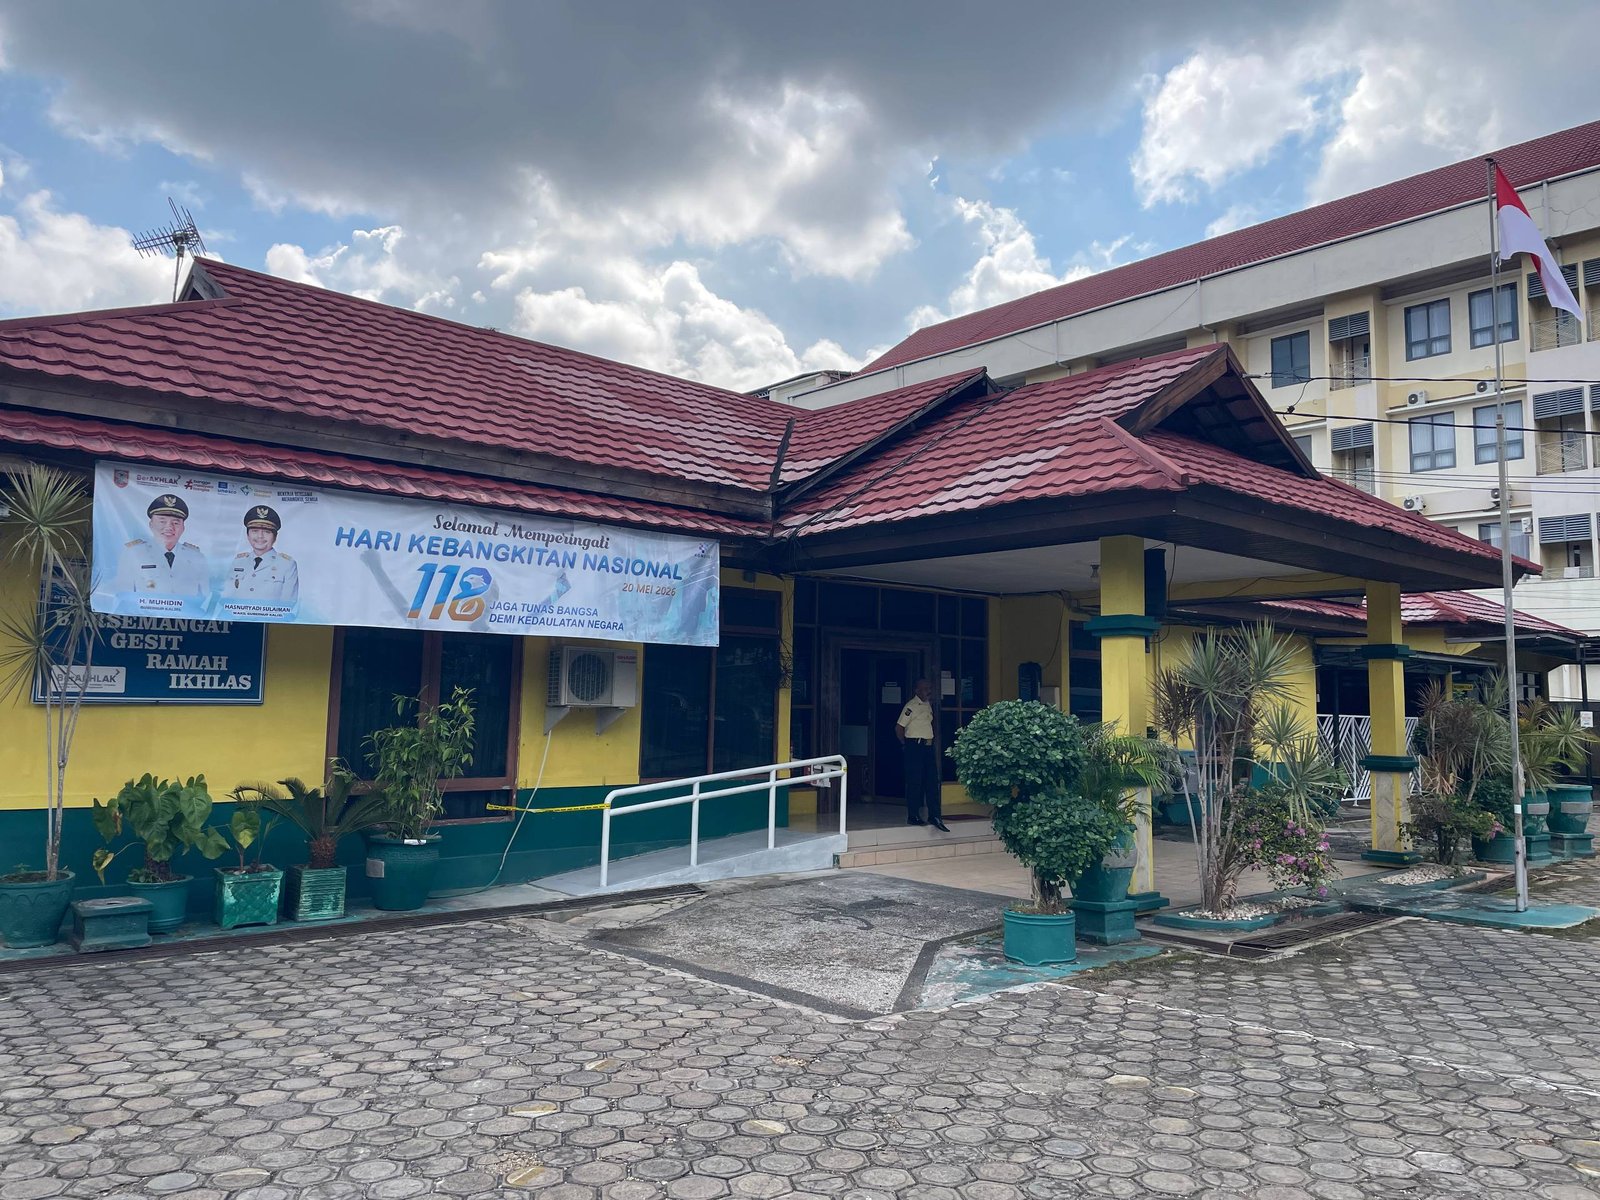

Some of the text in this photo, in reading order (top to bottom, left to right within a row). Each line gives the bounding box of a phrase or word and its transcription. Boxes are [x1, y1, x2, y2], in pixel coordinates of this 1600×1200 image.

[136, 474, 178, 485] BerAKHLAK
[433, 514, 610, 550] Selamat Memperingati
[335, 526, 683, 581] HARI KEBANGKITAN NASIONAL
[407, 562, 493, 622] 118
[622, 582, 676, 597] 20 MEI 2026
[149, 599, 183, 607] MUHIDIN
[489, 600, 599, 617] JAGA TUNAS BANGSA
[489, 613, 625, 631] DEMI KEDAULATAN NEGARA
[110, 632, 183, 651] GESIT
[146, 653, 229, 671] RAMAH
[169, 673, 252, 690] IKHLAS
